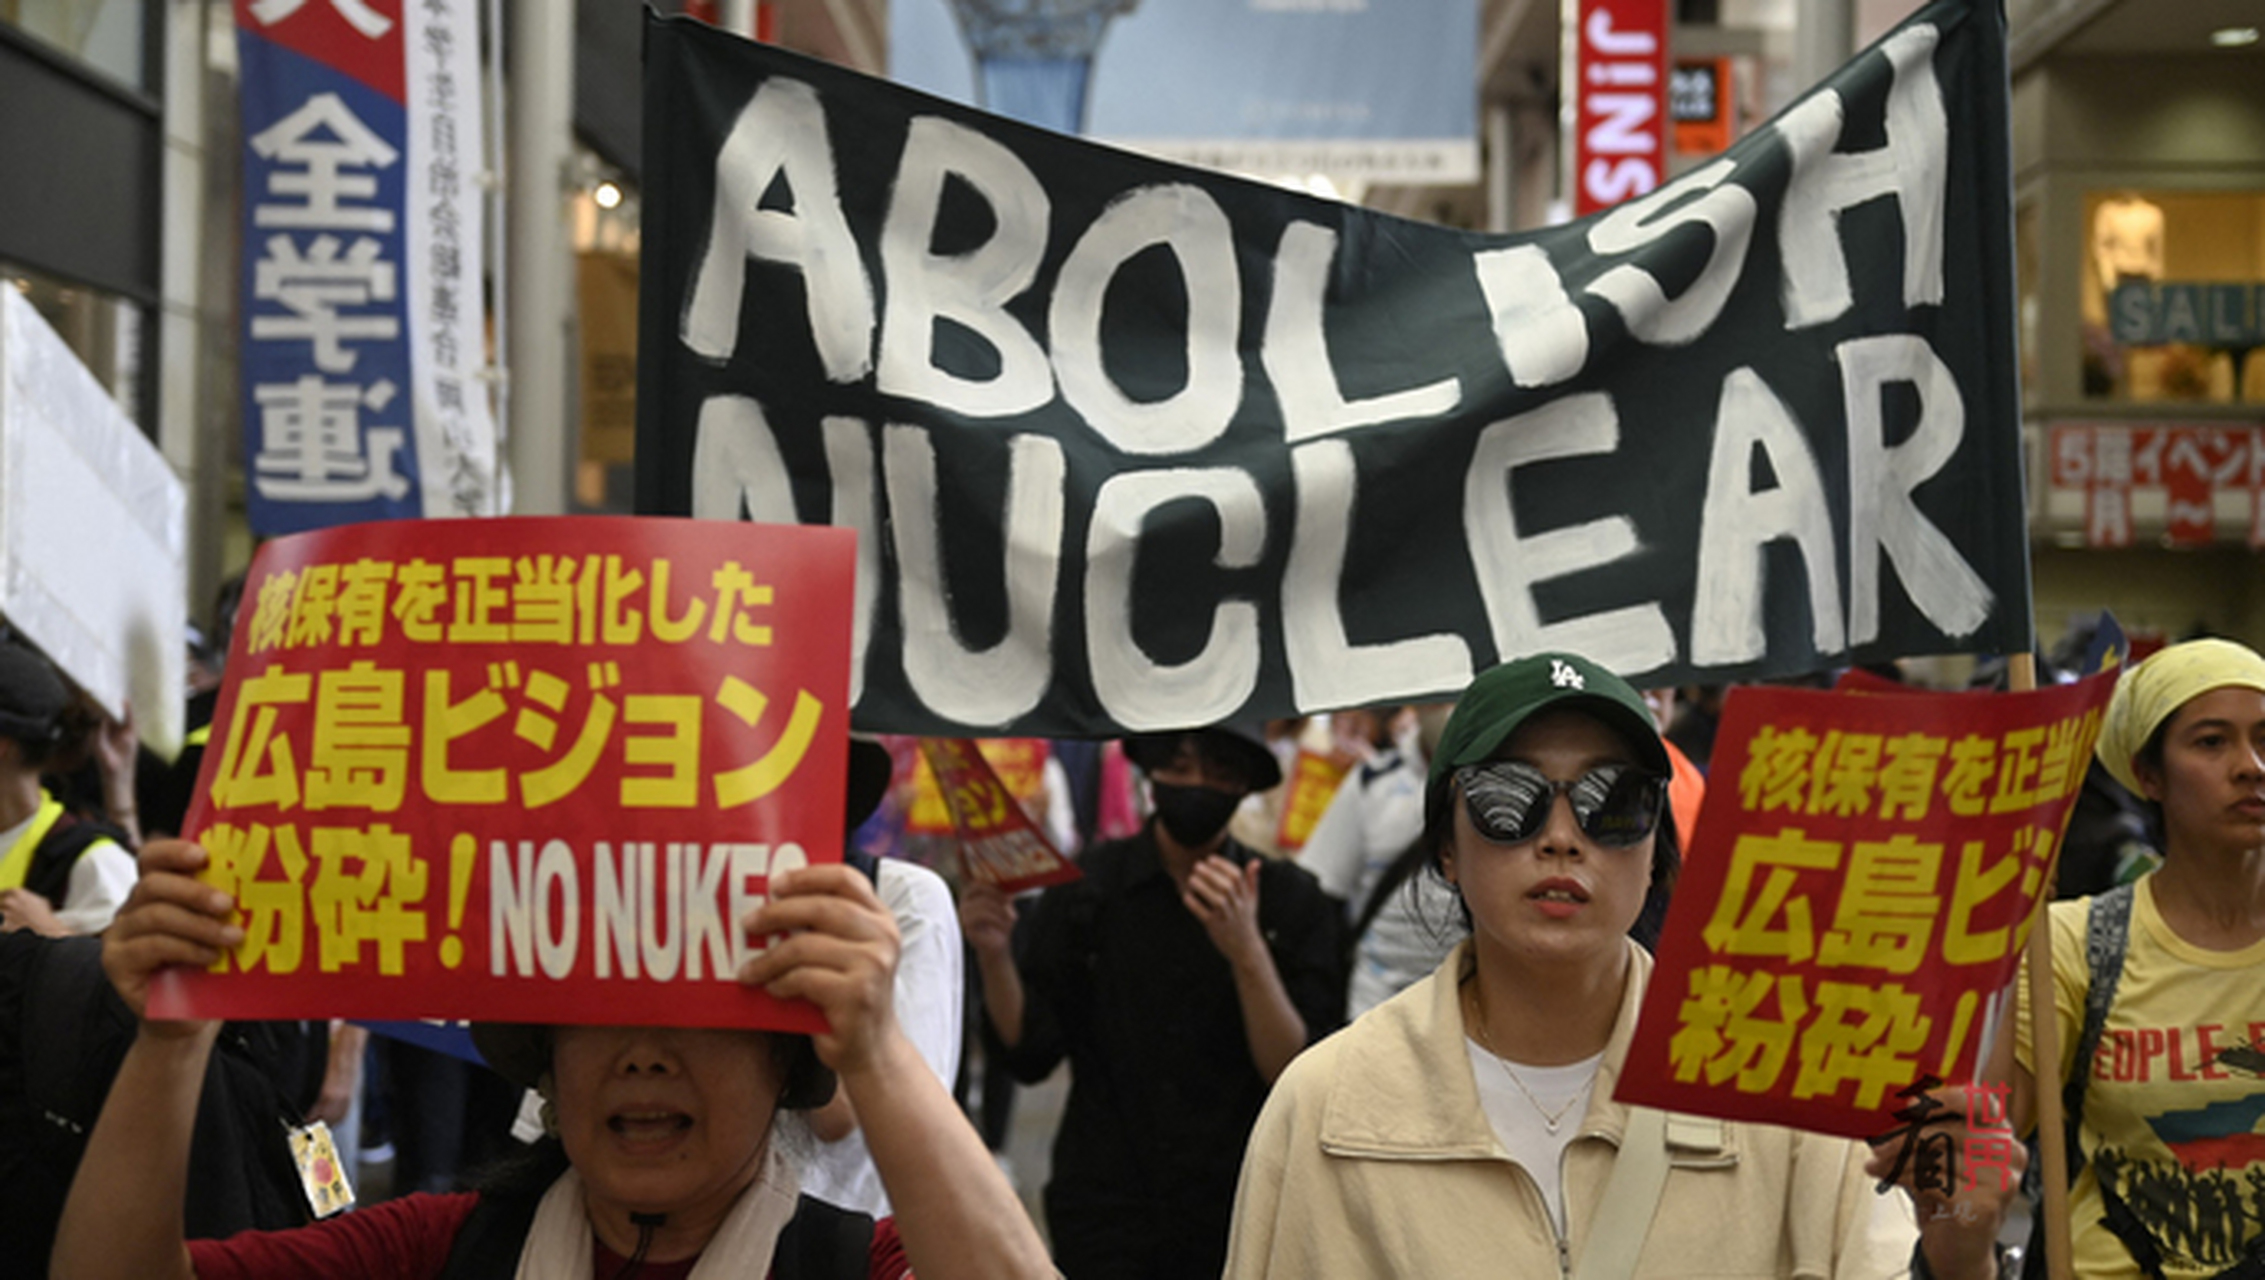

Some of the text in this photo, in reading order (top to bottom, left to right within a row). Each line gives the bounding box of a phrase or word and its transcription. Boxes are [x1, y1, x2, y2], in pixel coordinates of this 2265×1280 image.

[680, 21, 1948, 455] ABOLISH
[2119, 283, 2265, 343] SAL
[248, 555, 774, 655] 核保有を正当化した
[1551, 659, 1584, 690] LA
[210, 661, 823, 813] 広島ビジョン
[490, 838, 581, 980] NO
[2093, 1023, 2230, 1083] EOPLE
